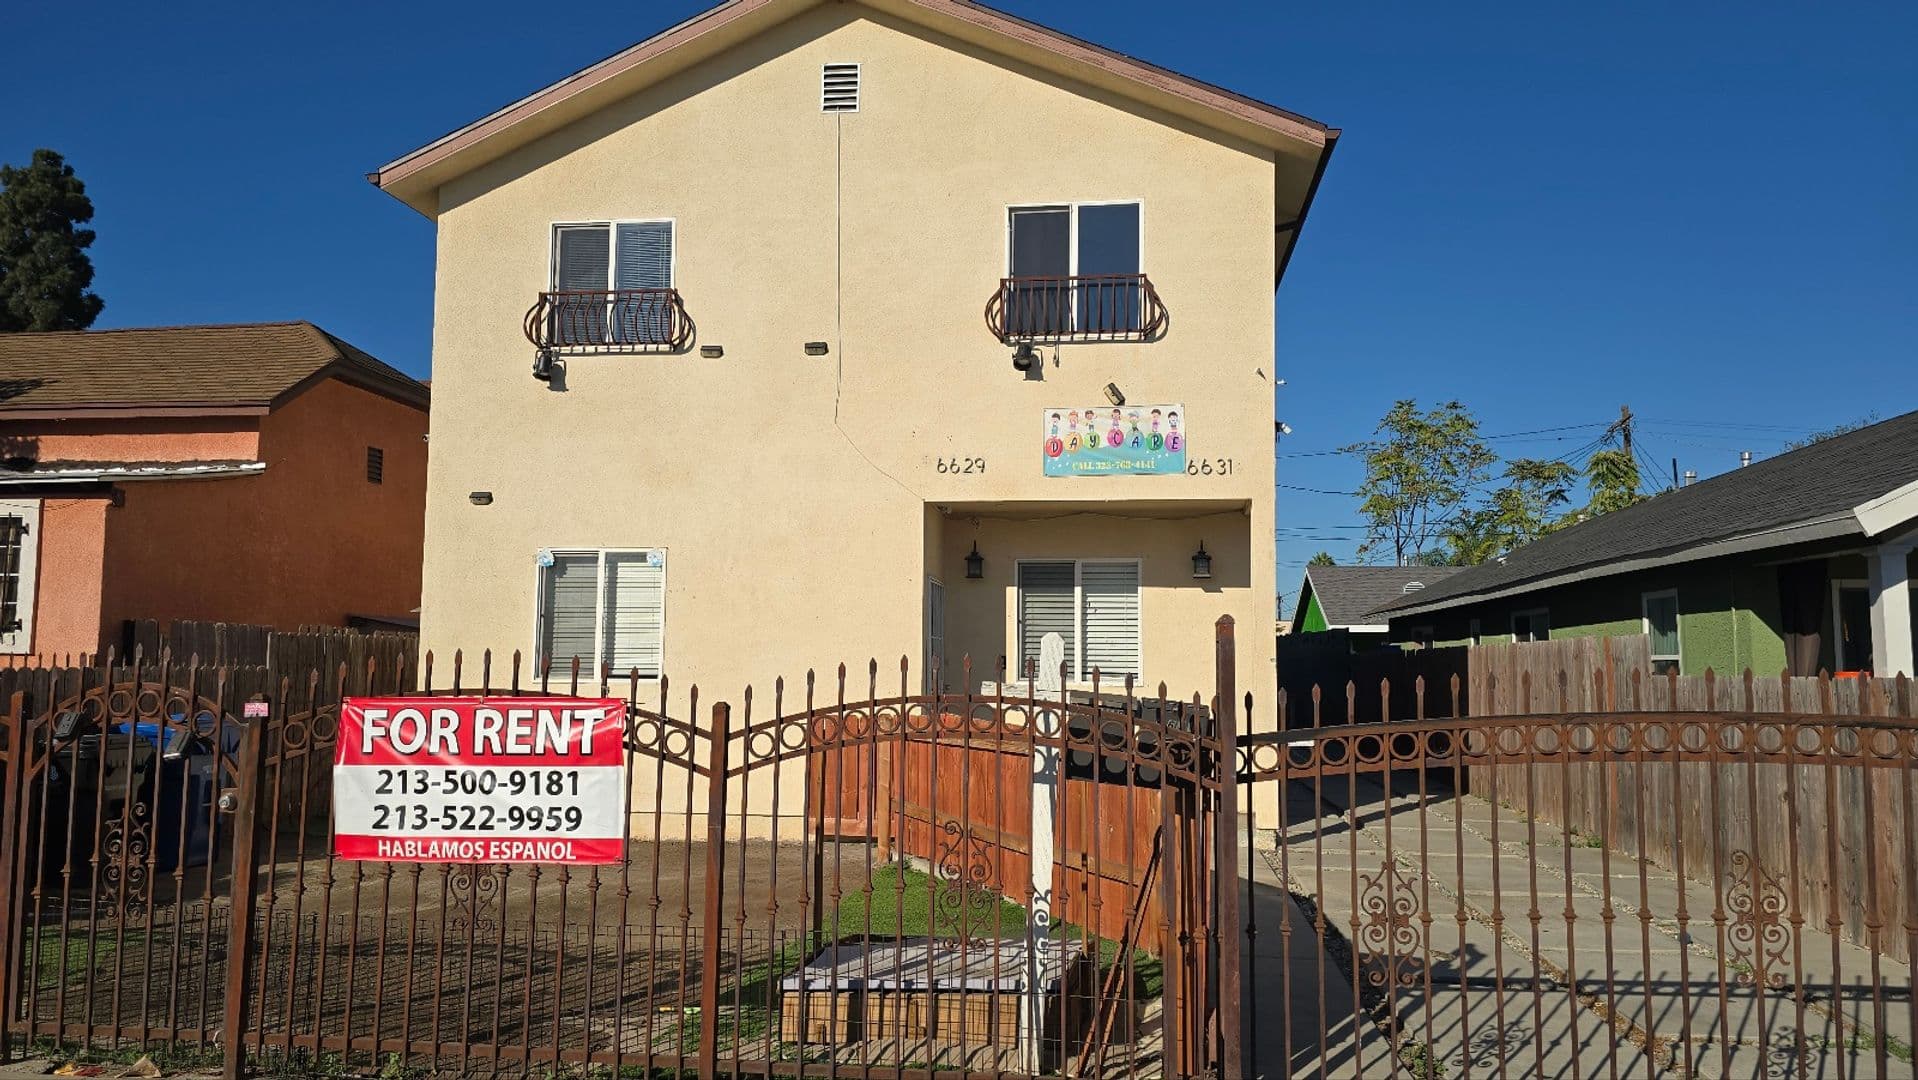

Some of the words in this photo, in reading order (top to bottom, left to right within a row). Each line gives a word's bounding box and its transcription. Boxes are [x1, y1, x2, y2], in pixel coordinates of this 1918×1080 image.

[1050, 432, 1097, 452] DAY
[1112, 431, 1180, 450] CARE
[936, 457, 986, 474] 6629
[1072, 461, 1095, 471] CALL
[1187, 458, 1234, 475] 6631
[361, 708, 461, 756] FOR
[473, 708, 607, 757] RENT
[375, 769, 579, 796] 213-500-9181
[371, 804, 583, 832] 213-522-9959
[378, 839, 485, 860] HABLAMOS
[489, 841, 576, 860] ESPANOL
